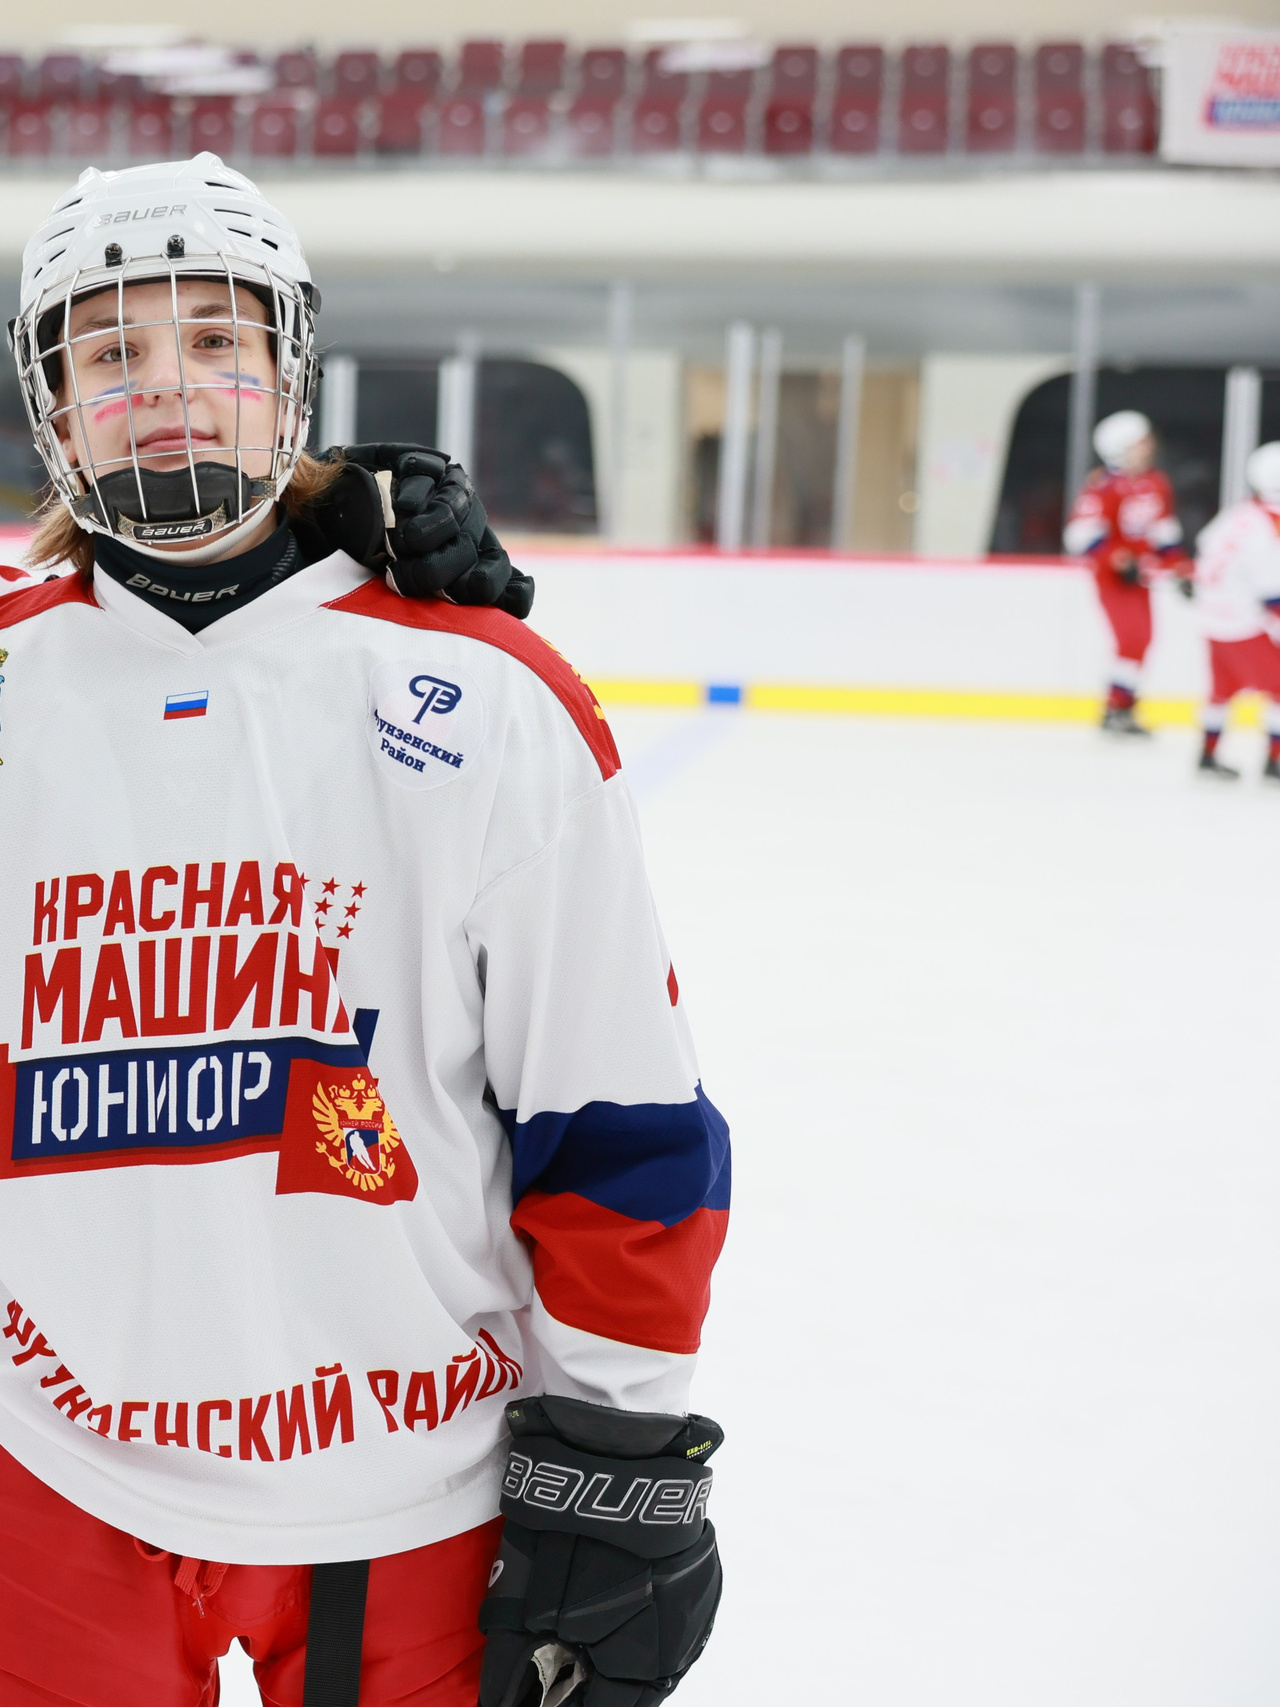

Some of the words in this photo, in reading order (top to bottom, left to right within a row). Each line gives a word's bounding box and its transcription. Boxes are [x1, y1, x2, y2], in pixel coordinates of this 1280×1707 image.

[93, 204, 187, 228] BAUER
[141, 522, 205, 536] BAUER
[126, 573, 240, 602] BAUER
[374, 708, 464, 769] унзенский
[380, 737, 426, 773] Район
[33, 860, 306, 946] КРАСНАЯ
[31, 1051, 272, 1145] ЮНИОР
[501, 1451, 714, 1525] BAUER
